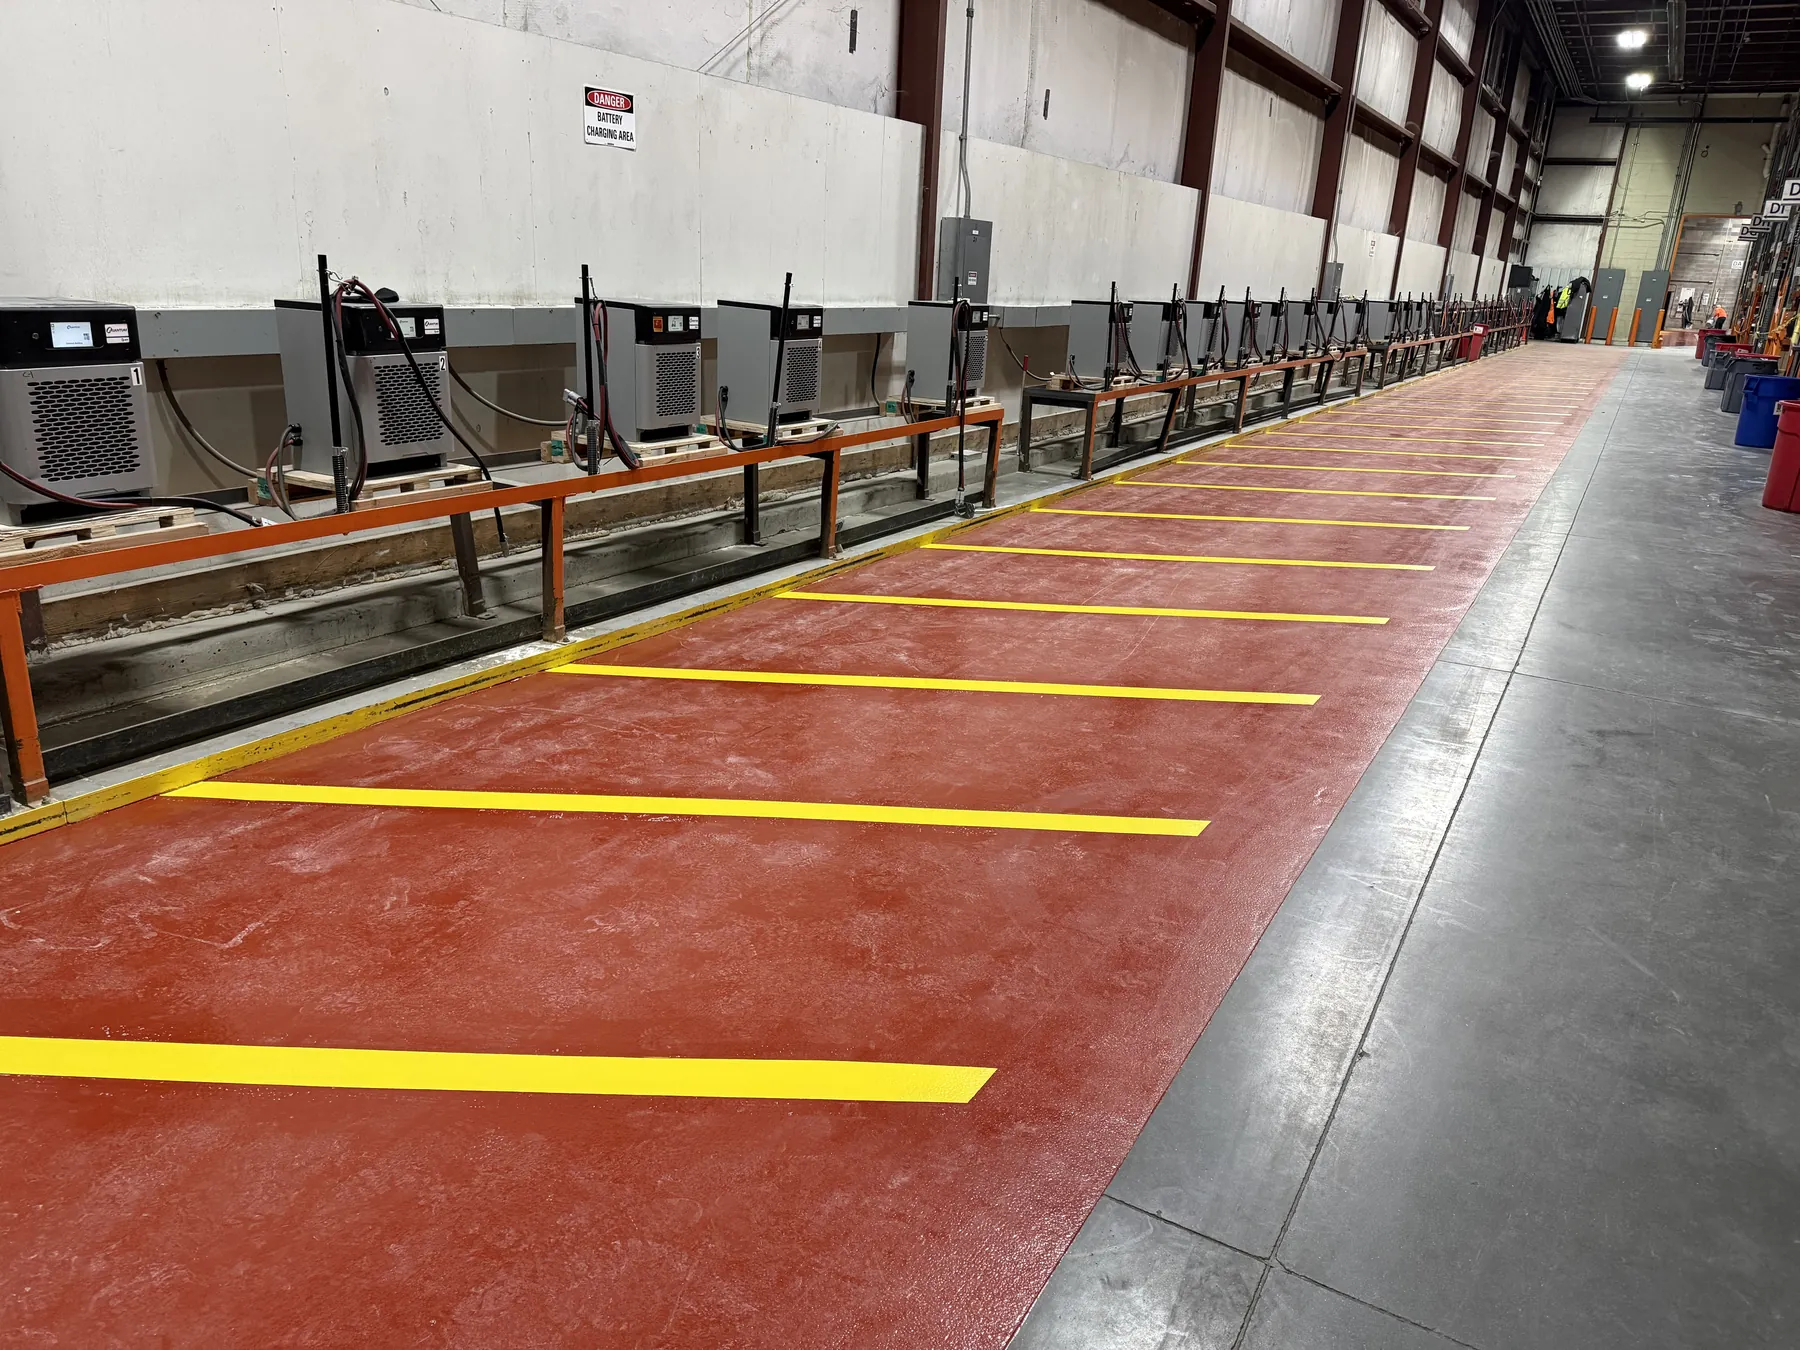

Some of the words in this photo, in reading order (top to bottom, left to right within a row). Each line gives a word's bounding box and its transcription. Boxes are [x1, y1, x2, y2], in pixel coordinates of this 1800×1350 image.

[594, 92, 625, 108] DANGER
[597, 111, 623, 125] BATTERY
[586, 125, 618, 140] CHARGING
[618, 130, 635, 142] AREA
[1789, 182, 1800, 196] D
[440, 357, 446, 371] 2
[133, 367, 140, 385] 1
